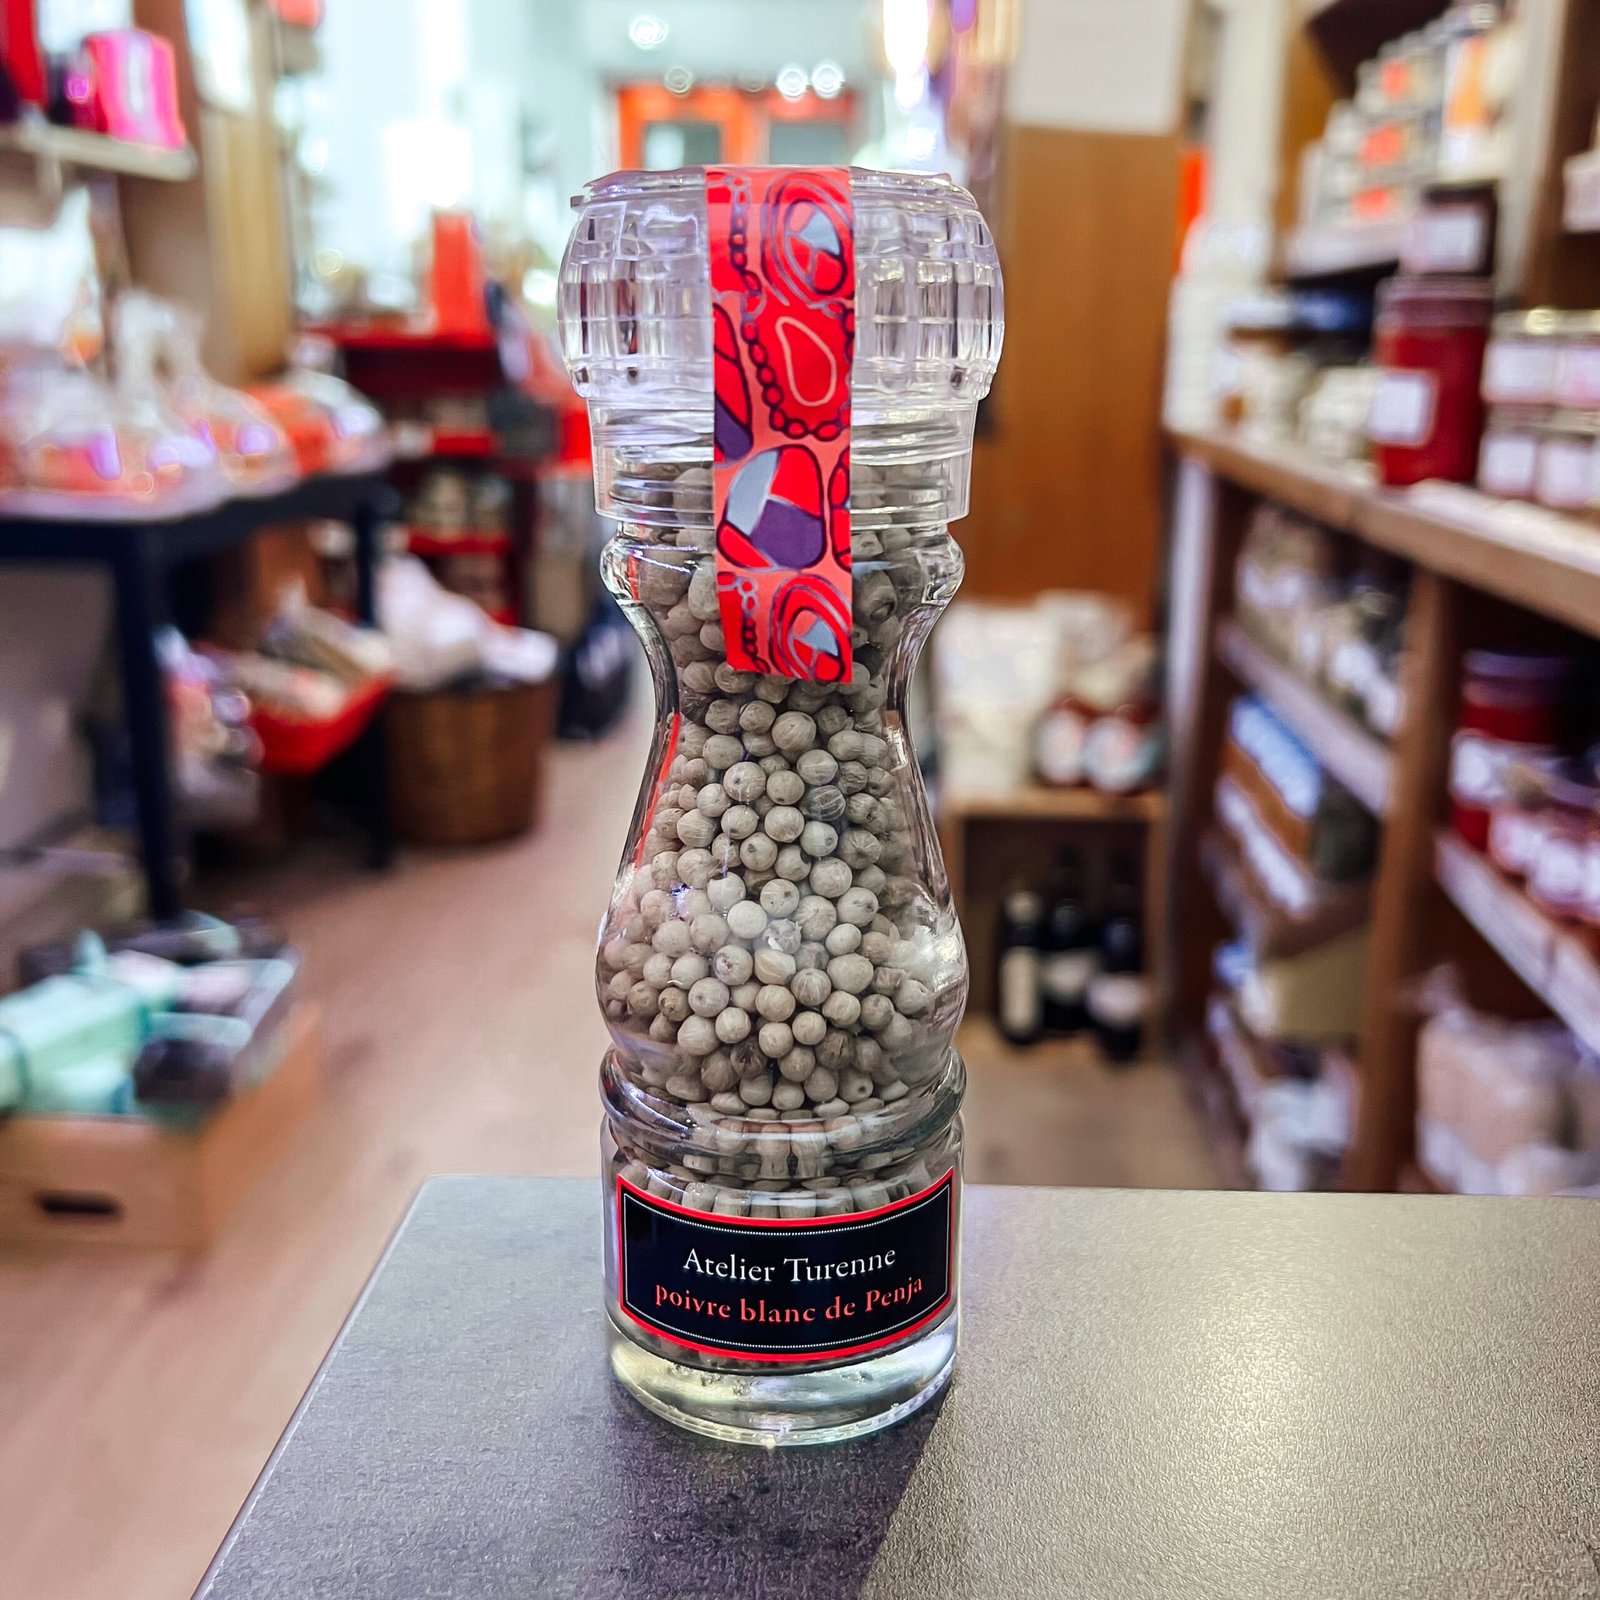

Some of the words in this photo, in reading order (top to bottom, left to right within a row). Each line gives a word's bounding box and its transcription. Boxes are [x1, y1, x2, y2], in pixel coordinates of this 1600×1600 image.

[683, 1248, 775, 1282] Atelier
[783, 1249, 896, 1282] Turenne
[655, 1284, 731, 1318] poivre
[740, 1298, 816, 1323] blanc
[825, 1296, 856, 1319] de
[865, 1276, 923, 1313] Penja
